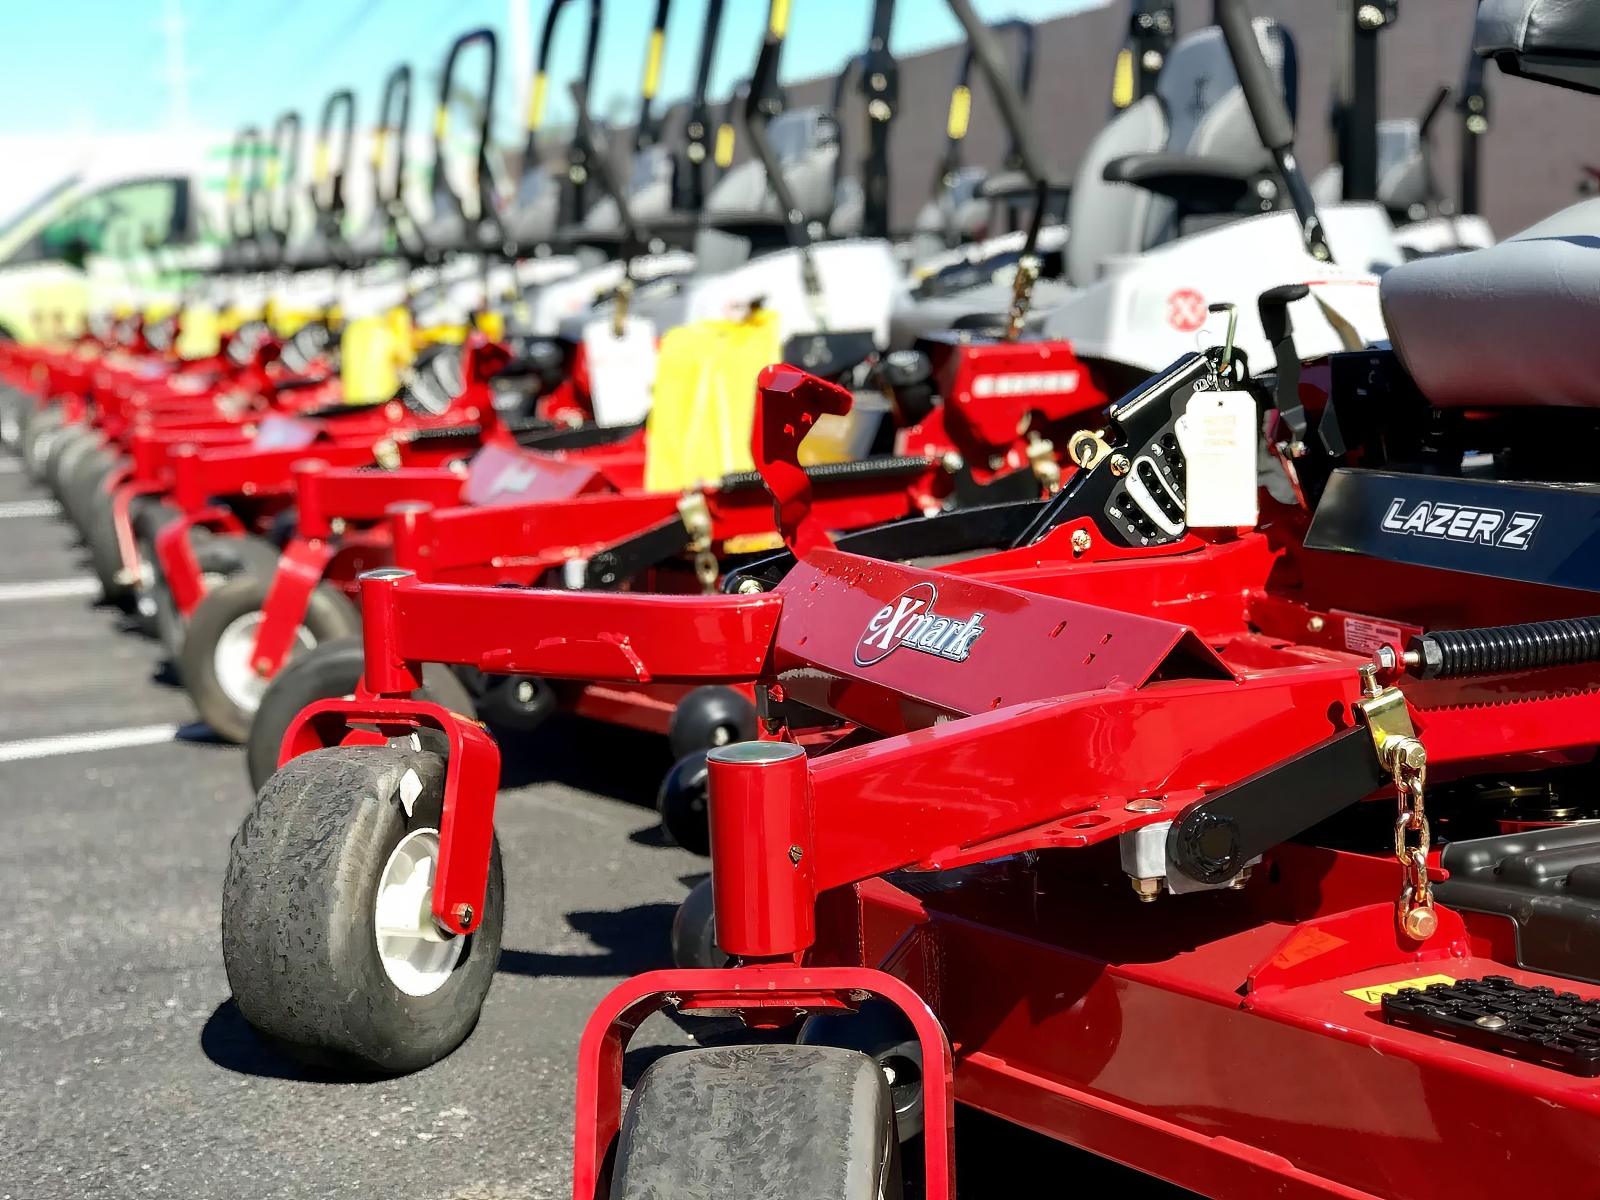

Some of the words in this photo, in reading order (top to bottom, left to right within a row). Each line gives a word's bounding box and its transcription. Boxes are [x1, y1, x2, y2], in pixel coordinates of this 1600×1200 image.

[1382, 499, 1503, 545] LAZER
[1498, 513, 1541, 549] Z
[863, 597, 984, 661] eXmark
